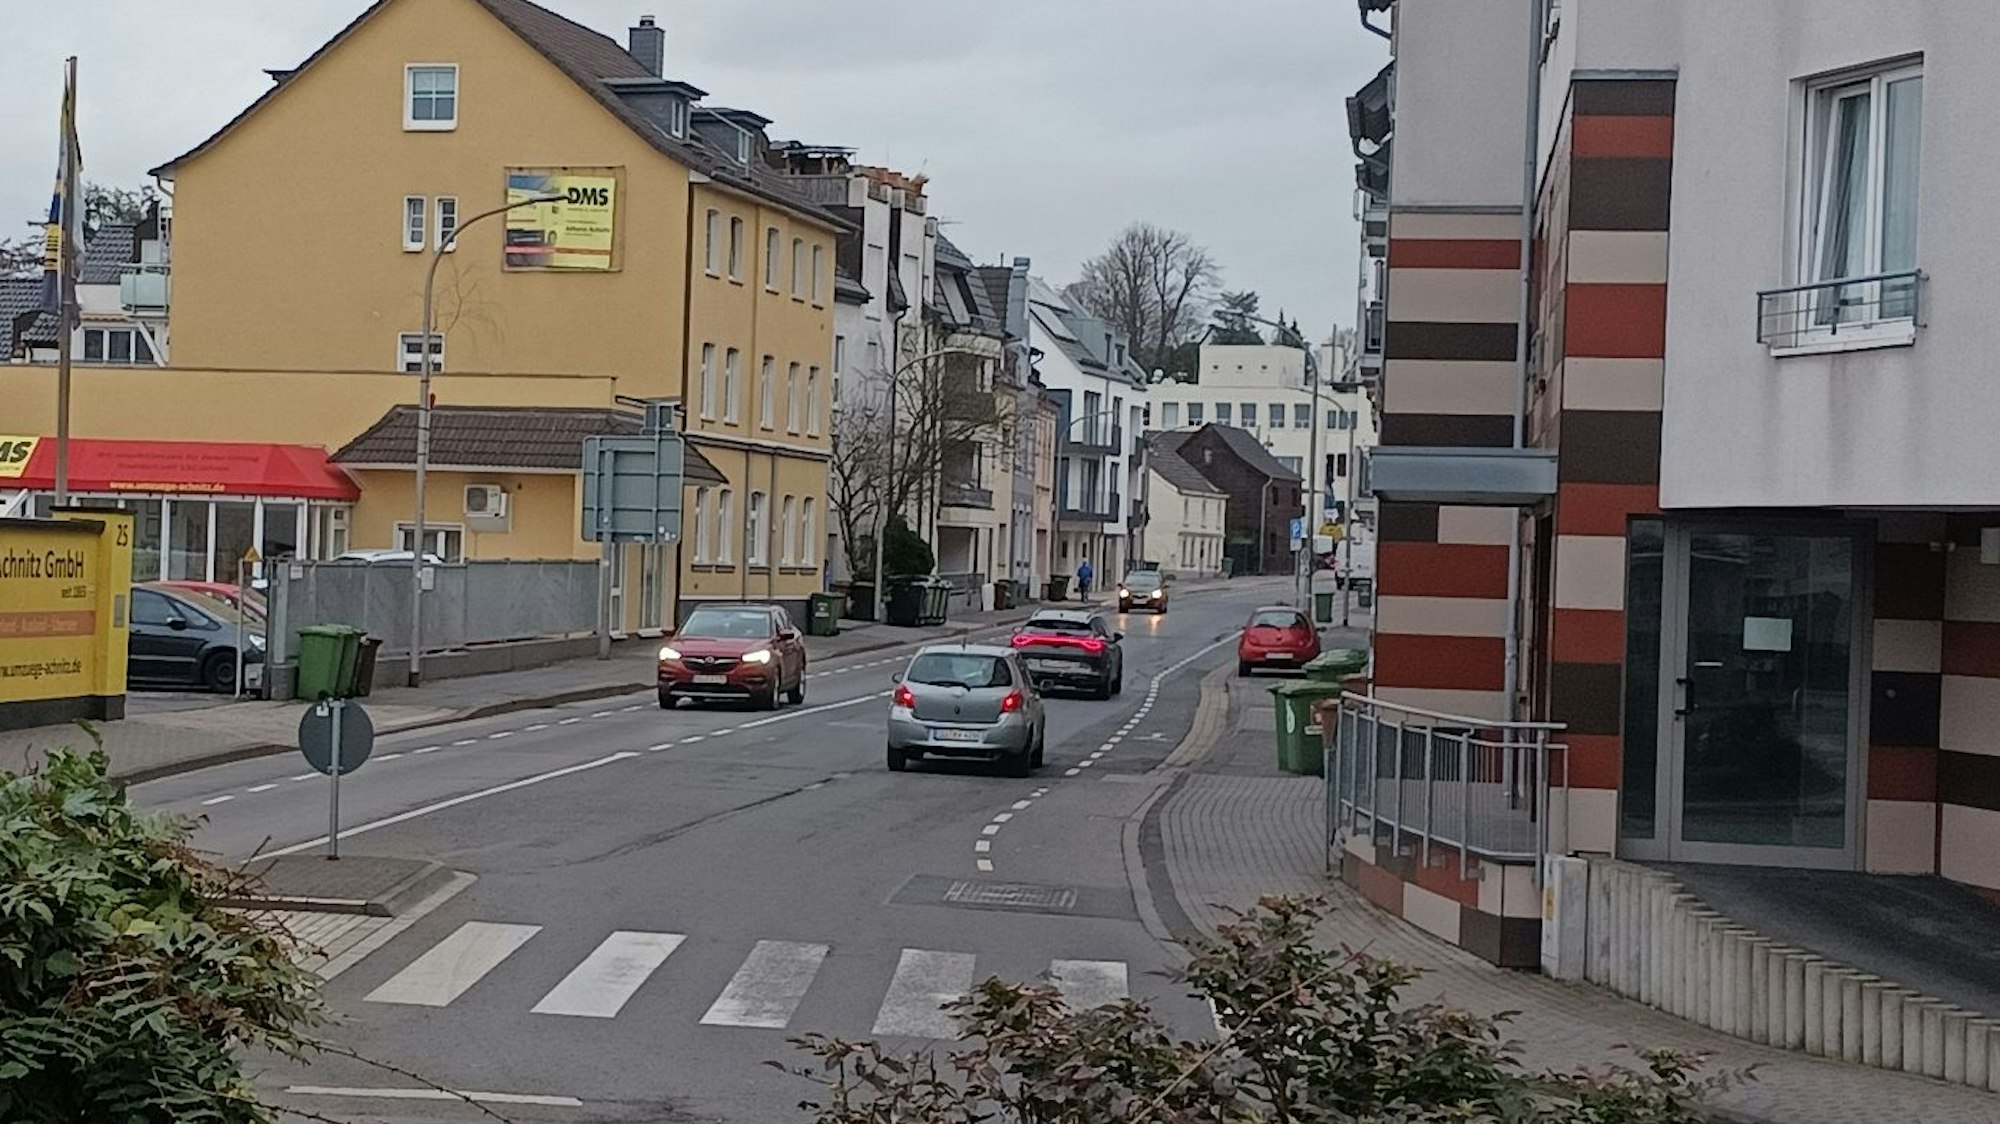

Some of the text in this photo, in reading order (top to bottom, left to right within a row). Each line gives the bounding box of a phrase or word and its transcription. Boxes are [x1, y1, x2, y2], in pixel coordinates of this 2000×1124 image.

[568, 187, 608, 206] DMS
[116, 525, 128, 546] 25
[0, 548, 84, 578] chnitz GmbH
